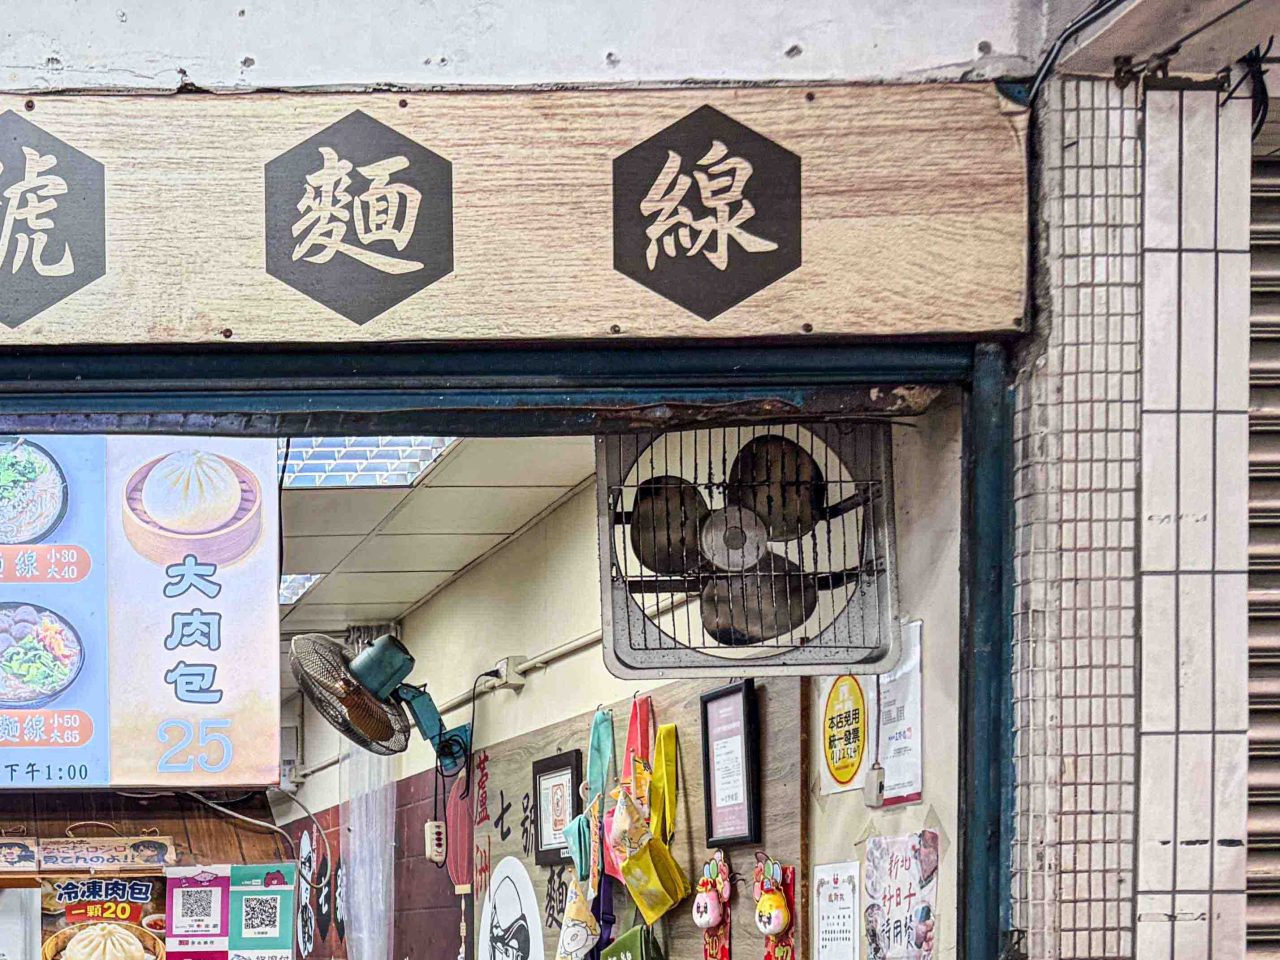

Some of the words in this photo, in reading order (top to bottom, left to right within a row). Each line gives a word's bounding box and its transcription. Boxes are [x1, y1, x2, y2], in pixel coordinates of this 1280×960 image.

[163, 553, 223, 705] 大肉包
[156, 717, 234, 774] 25
